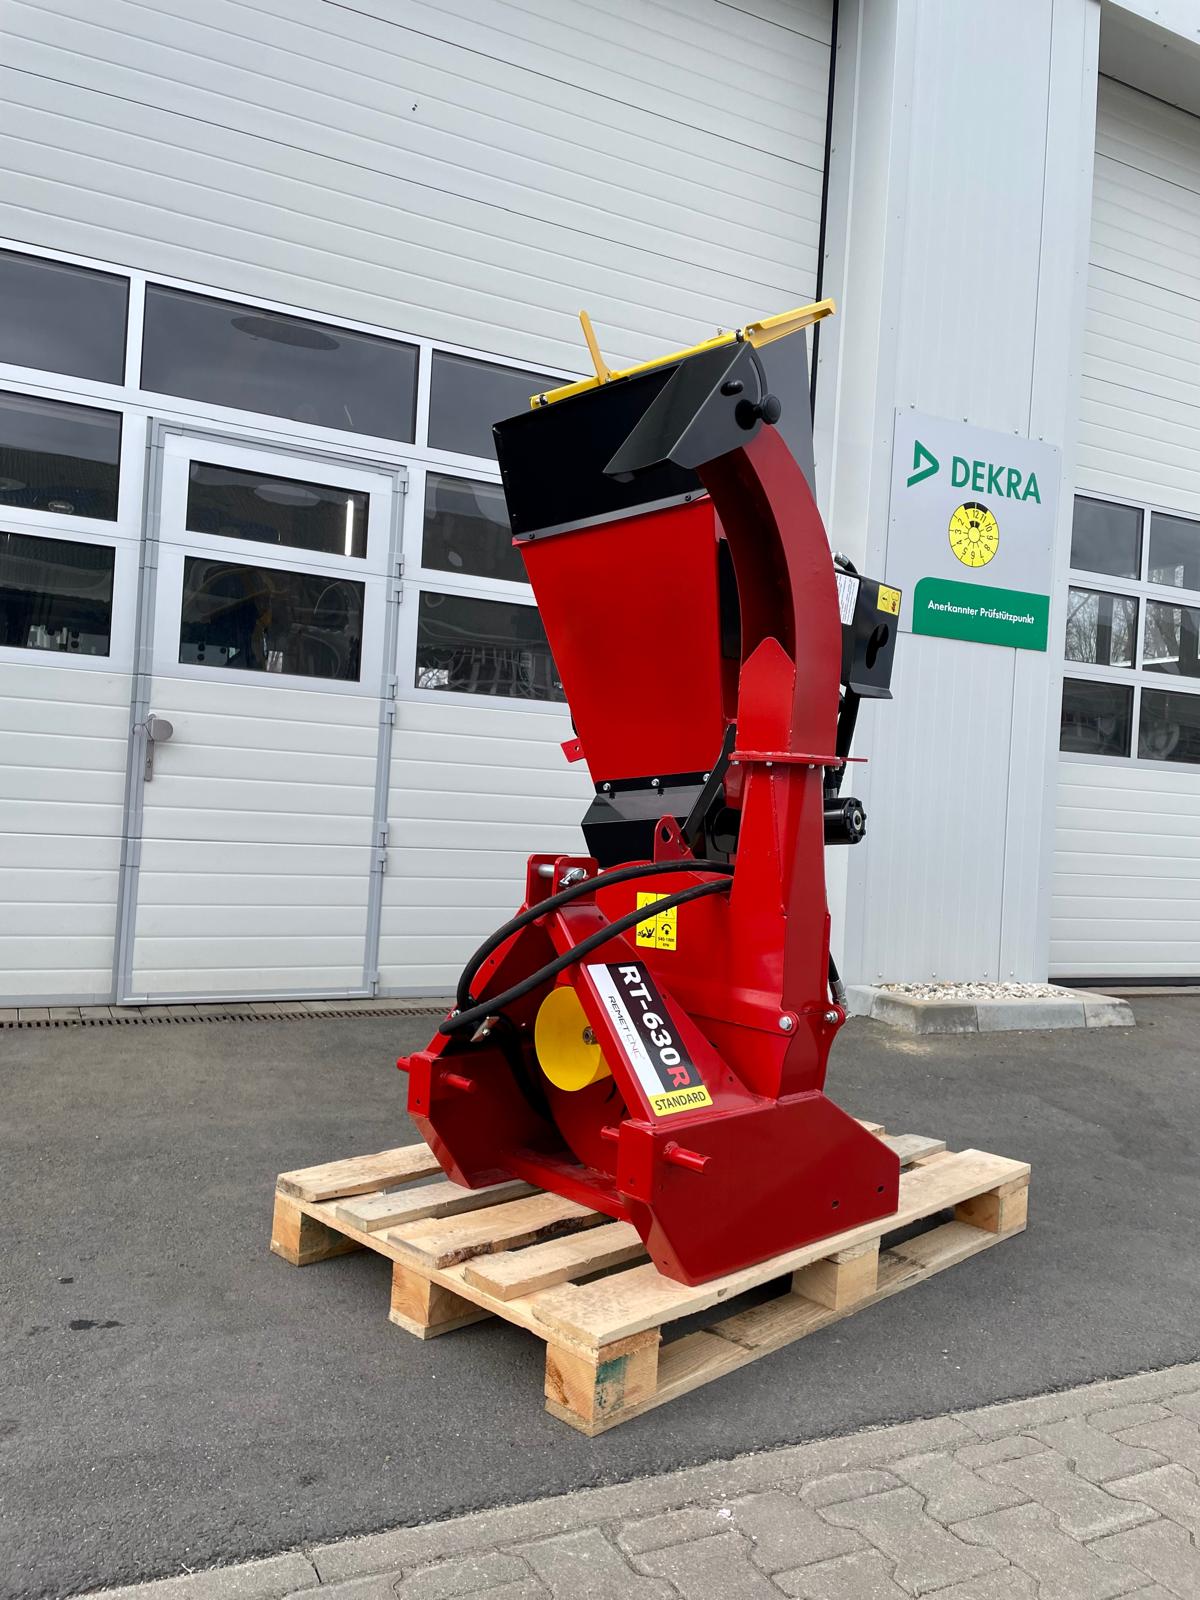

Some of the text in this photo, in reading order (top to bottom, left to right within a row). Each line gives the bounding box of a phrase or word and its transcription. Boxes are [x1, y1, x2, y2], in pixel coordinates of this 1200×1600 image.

[951, 455, 1042, 504] DEKRA
[973, 509, 979, 519] 12
[957, 517, 965, 526] 2
[985, 523, 993, 532] 10
[962, 546, 968, 555] 5
[983, 543, 991, 551] 8
[970, 551, 975, 559] 6
[928, 599, 1035, 624] Anerkannter Prüfstützpunkt
[608, 995, 631, 1032] REMET
[618, 965, 691, 1088] RT-630R
[655, 1091, 706, 1111] STANDARD
